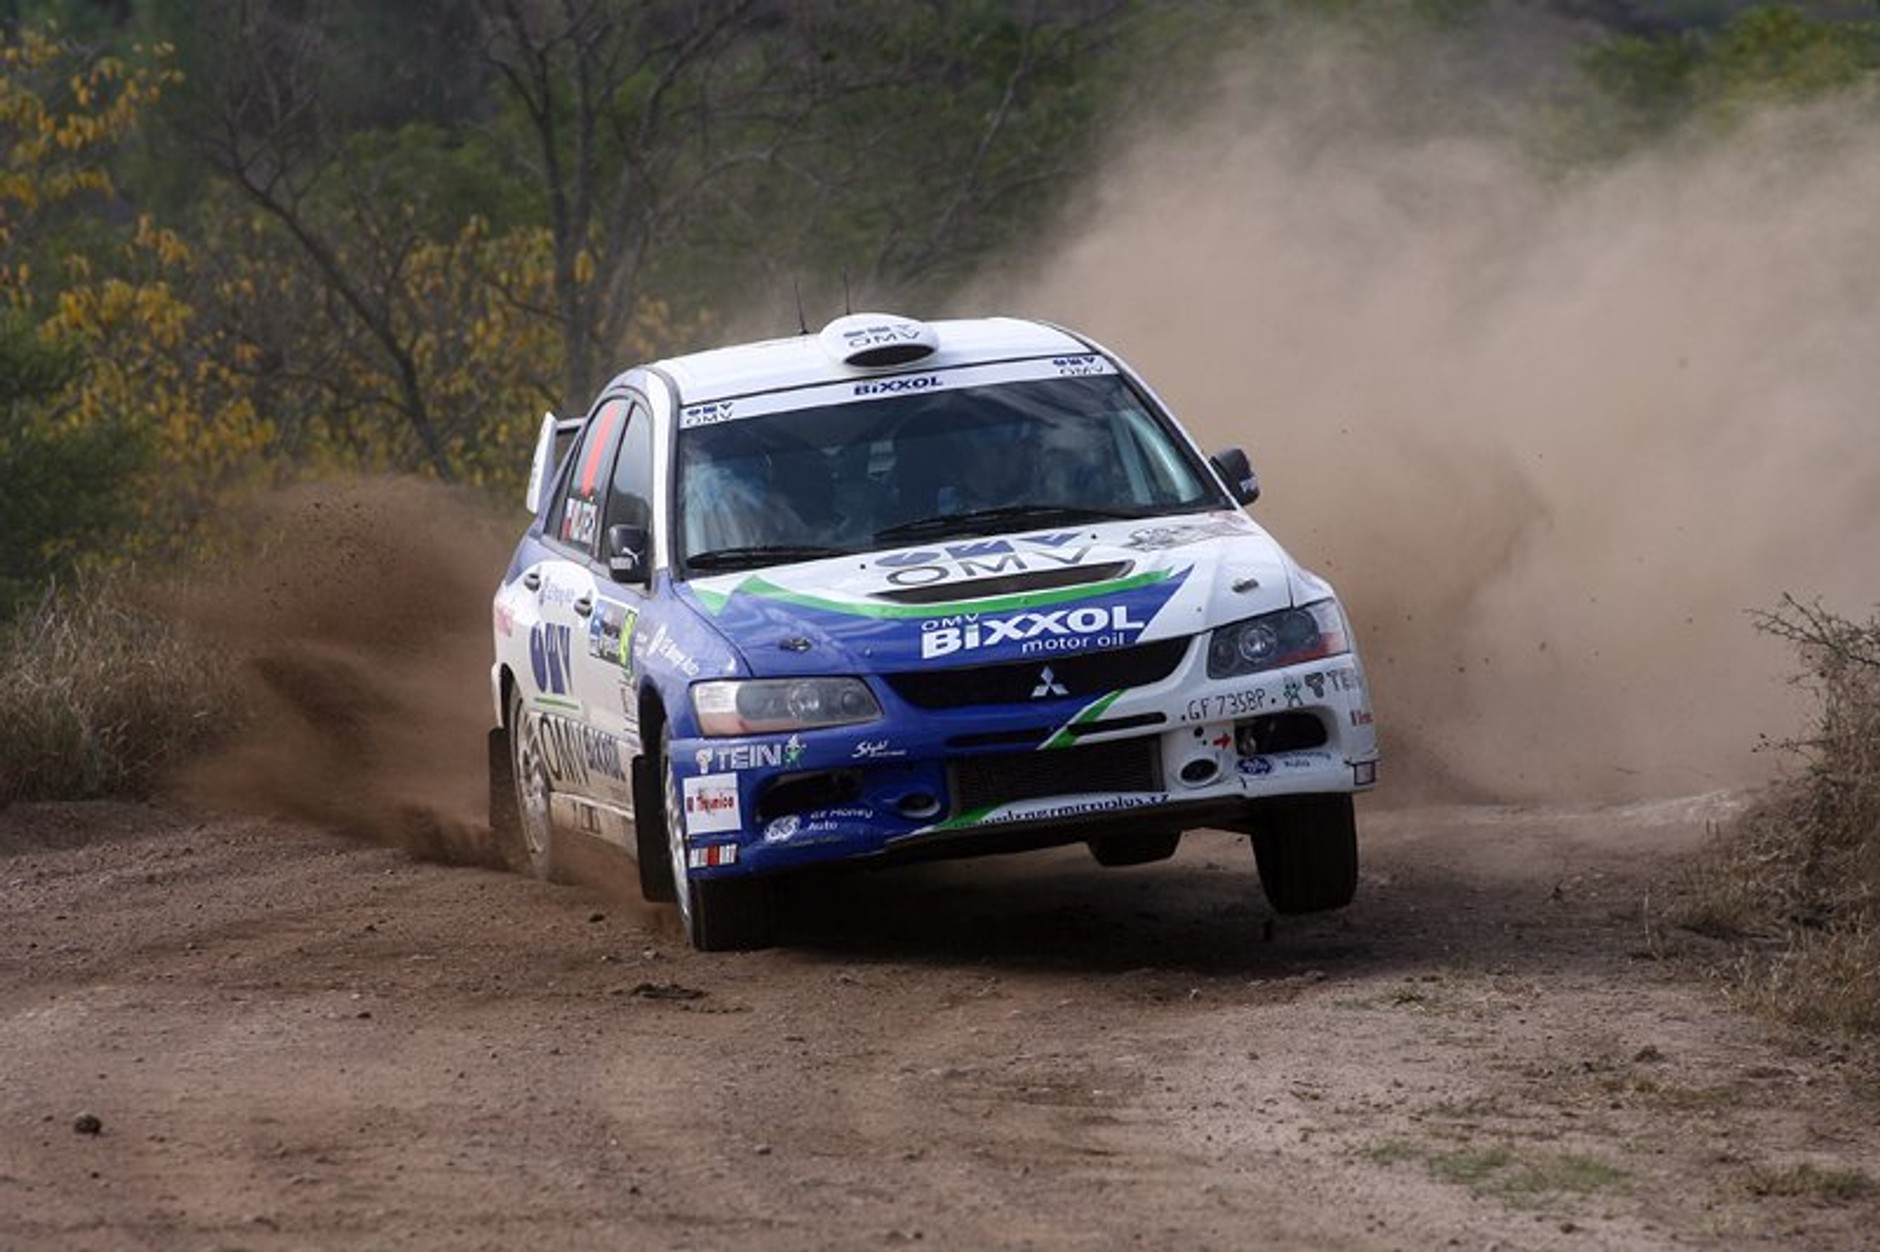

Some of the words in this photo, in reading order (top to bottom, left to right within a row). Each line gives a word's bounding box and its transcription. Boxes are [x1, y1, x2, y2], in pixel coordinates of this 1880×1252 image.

[886, 546, 1092, 586] OMV
[1021, 637, 1090, 654] motor
[1096, 632, 1125, 648] oil
[717, 744, 782, 770] TEIN
[828, 807, 874, 820] Money
[807, 820, 838, 831] Auto
